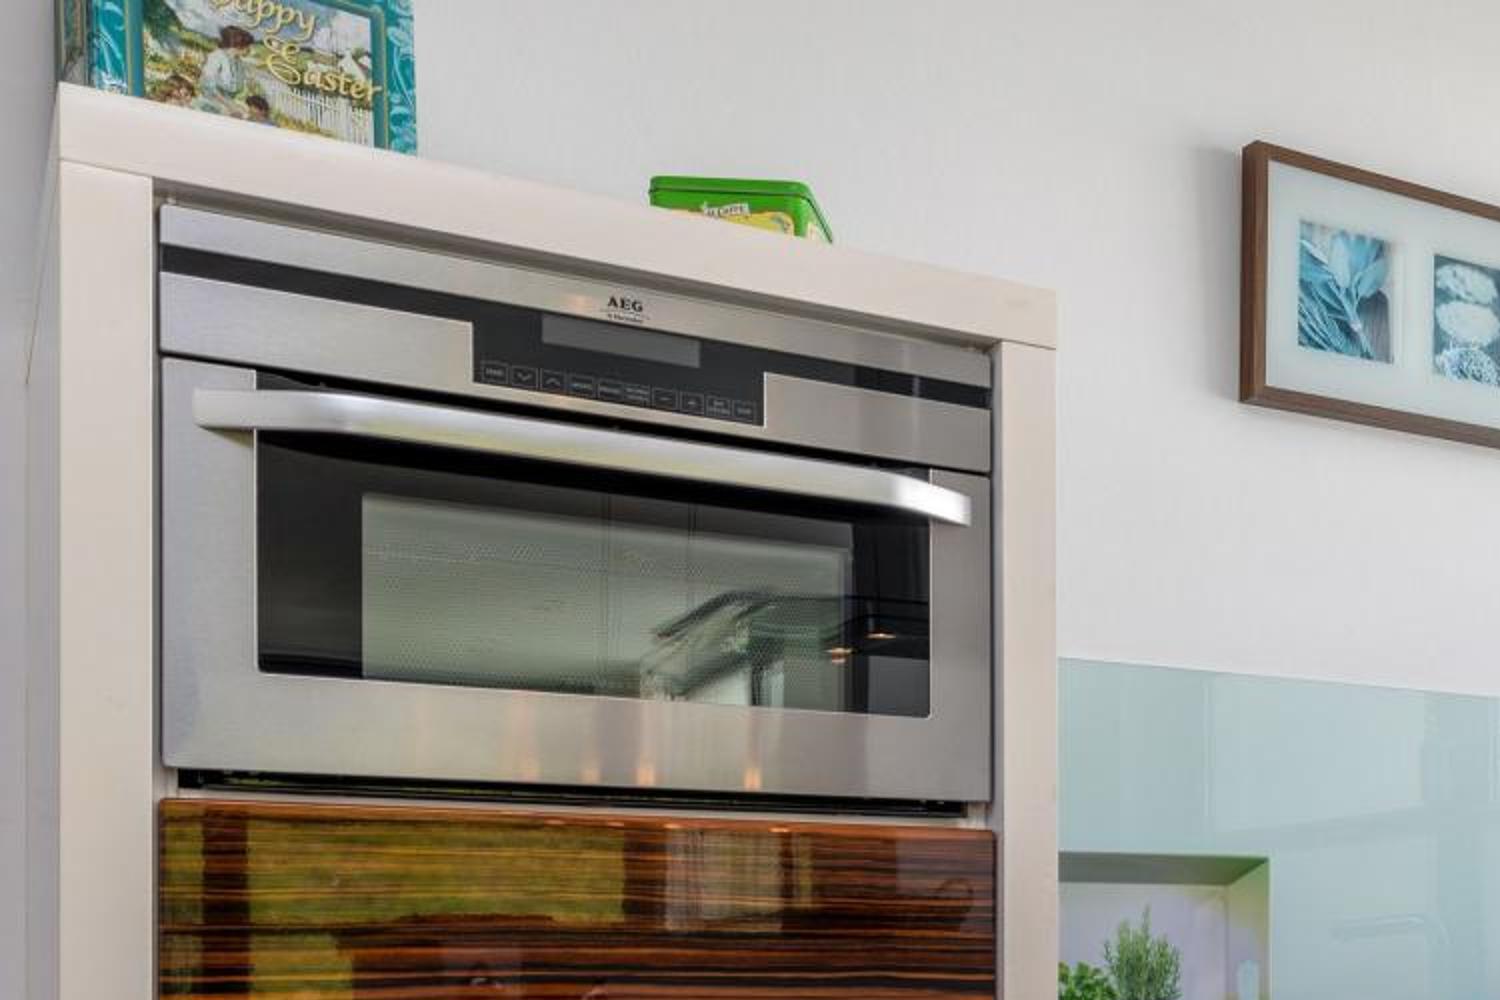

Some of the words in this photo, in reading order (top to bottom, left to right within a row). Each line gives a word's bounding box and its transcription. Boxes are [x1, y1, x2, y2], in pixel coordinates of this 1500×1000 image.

[207, 0, 317, 43] appy
[264, 35, 382, 101] Easter
[607, 295, 643, 312] AEG
